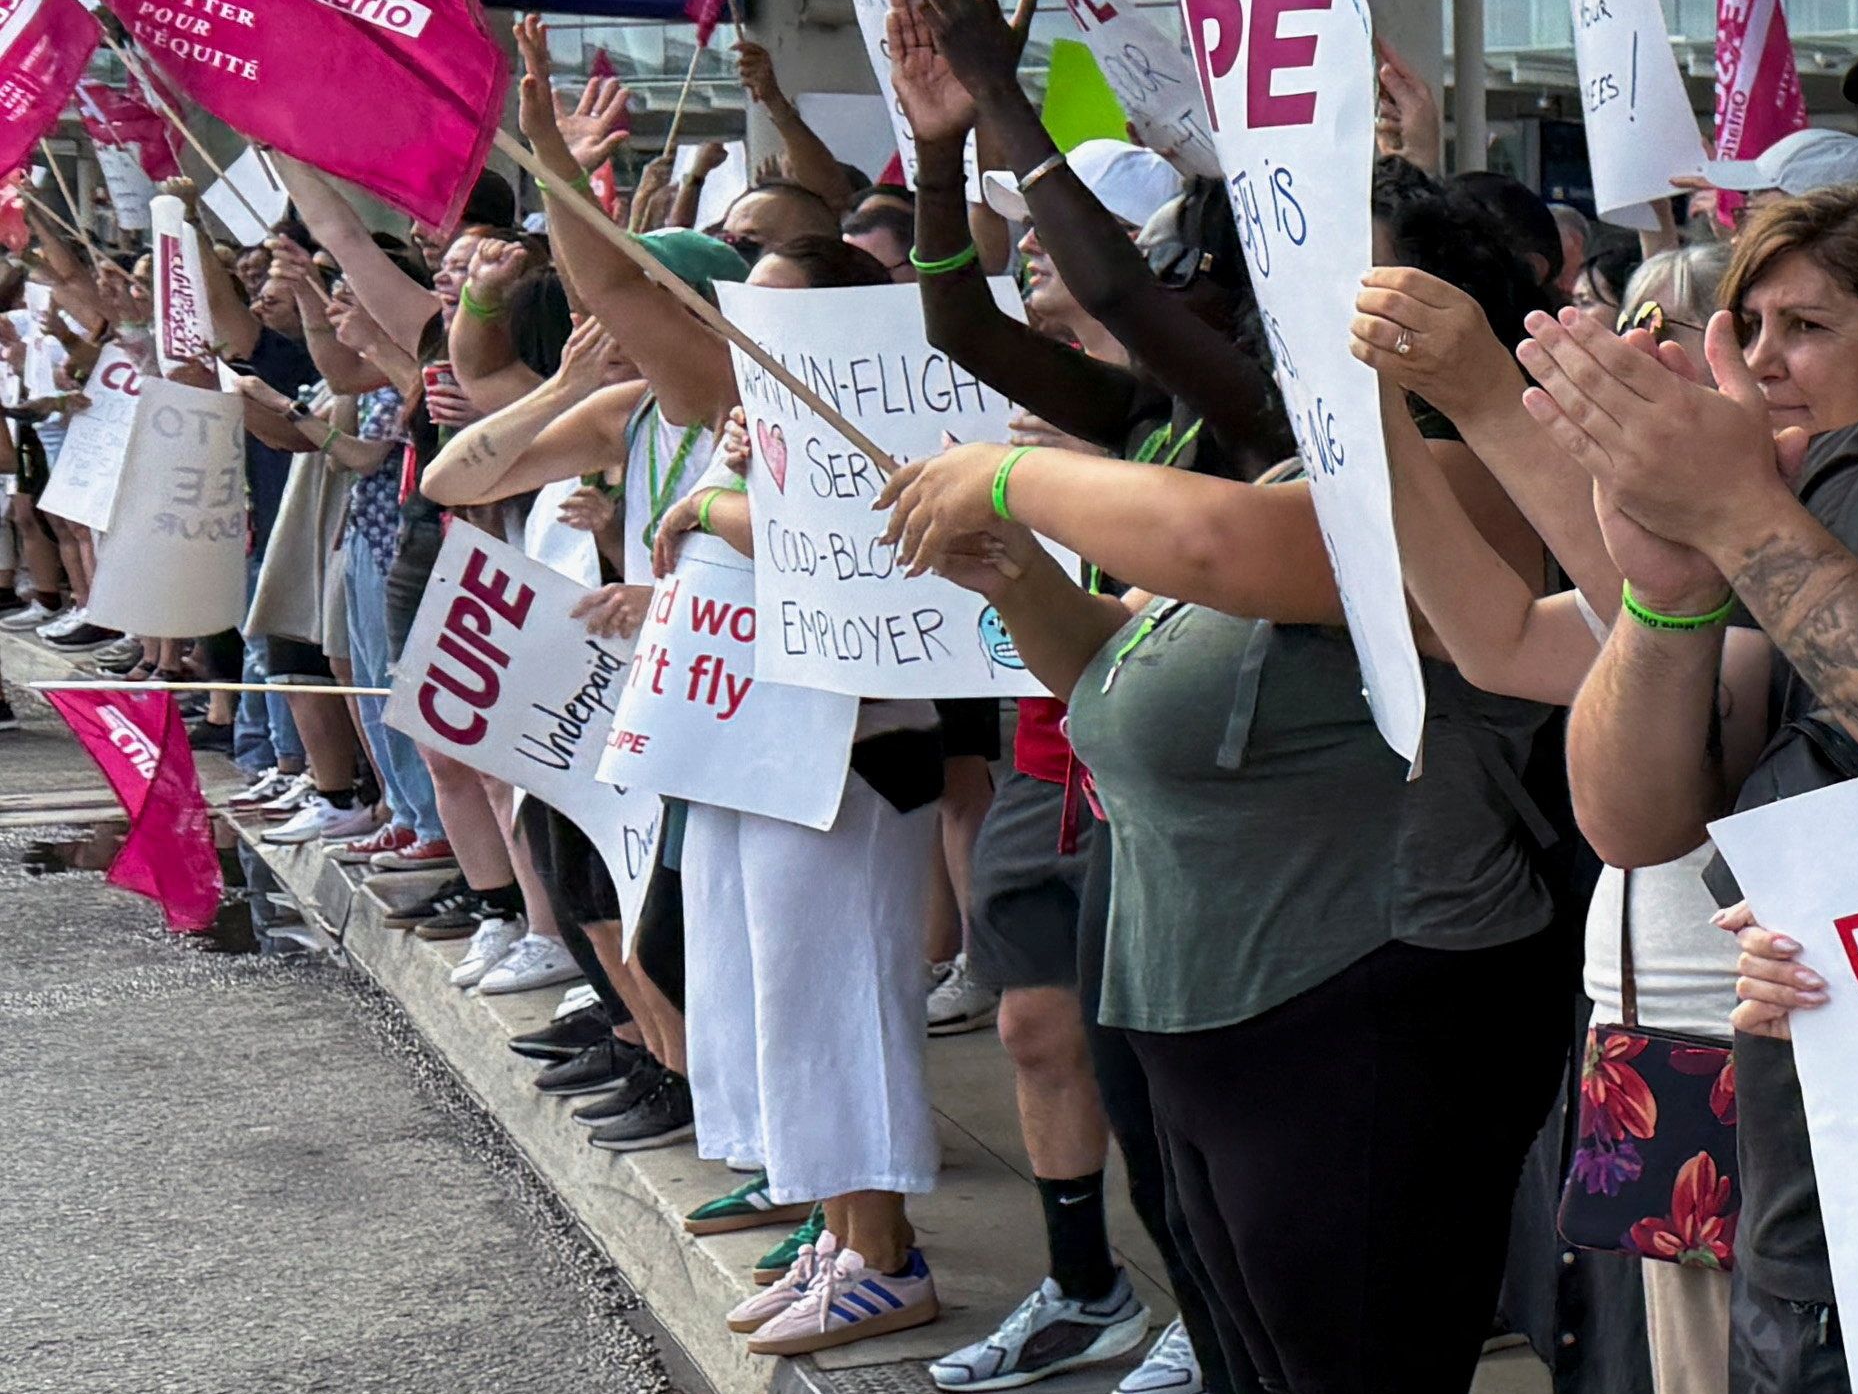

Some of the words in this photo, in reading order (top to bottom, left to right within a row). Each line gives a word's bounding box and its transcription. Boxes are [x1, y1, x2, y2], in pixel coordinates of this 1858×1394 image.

[138, 1, 212, 37] POUR
[800, 353, 1014, 419] IN-FLIGH
[418, 547, 536, 746] CUPE
[781, 600, 952, 667] EMPLOYER
[514, 639, 628, 772] Underpaid
[686, 654, 753, 721] fly
